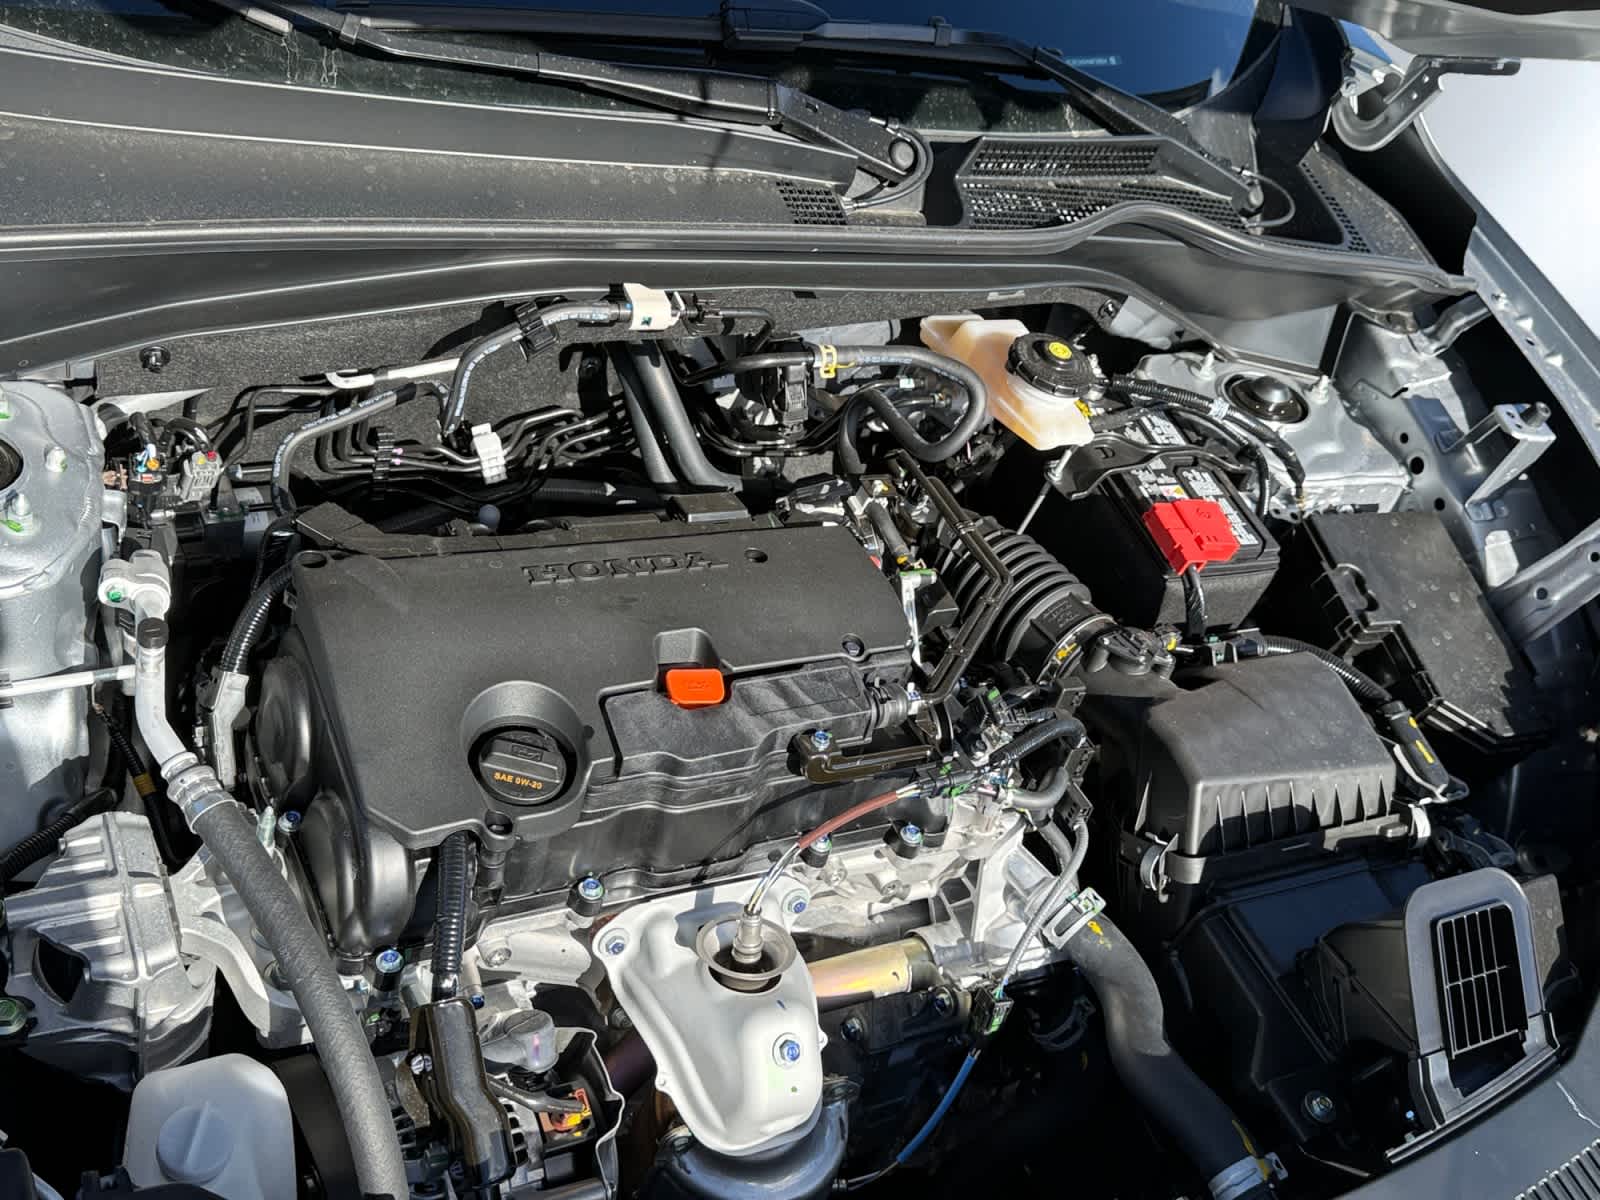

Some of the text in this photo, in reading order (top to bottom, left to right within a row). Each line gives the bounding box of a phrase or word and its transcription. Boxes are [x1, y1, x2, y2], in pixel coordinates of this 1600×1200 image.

[521, 552, 726, 585] HONDA
[493, 771, 543, 790] SAE 0W-20
